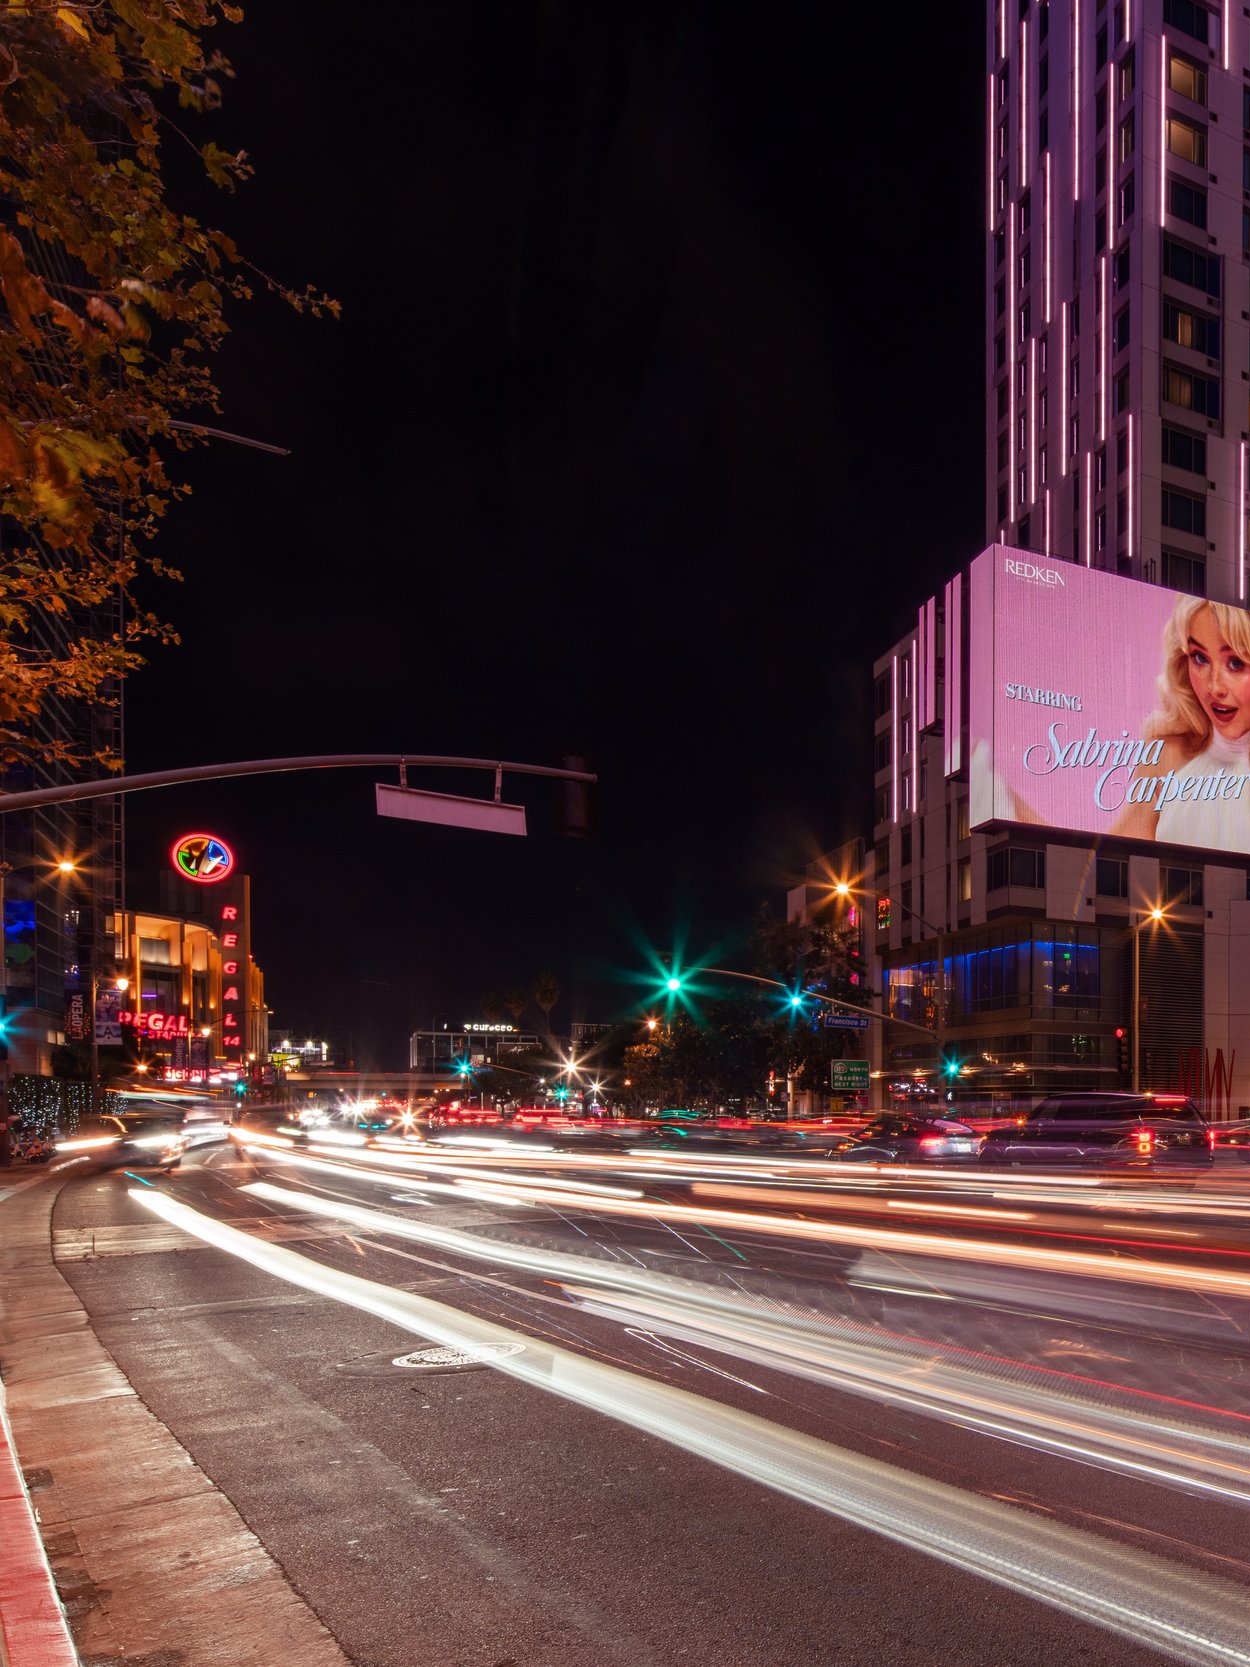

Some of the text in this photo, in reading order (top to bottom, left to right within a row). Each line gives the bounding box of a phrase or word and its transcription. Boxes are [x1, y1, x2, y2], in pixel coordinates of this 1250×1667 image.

[1005, 558, 1065, 586] REDKEN
[1005, 682, 1083, 712] STARRING
[1023, 722, 1165, 776] Sabrina
[222, 906, 239, 1027] REGAL
[118, 1012, 188, 1031] REGAL
[828, 1016, 867, 1027] Francisco St
[223, 1036, 240, 1046] 14
